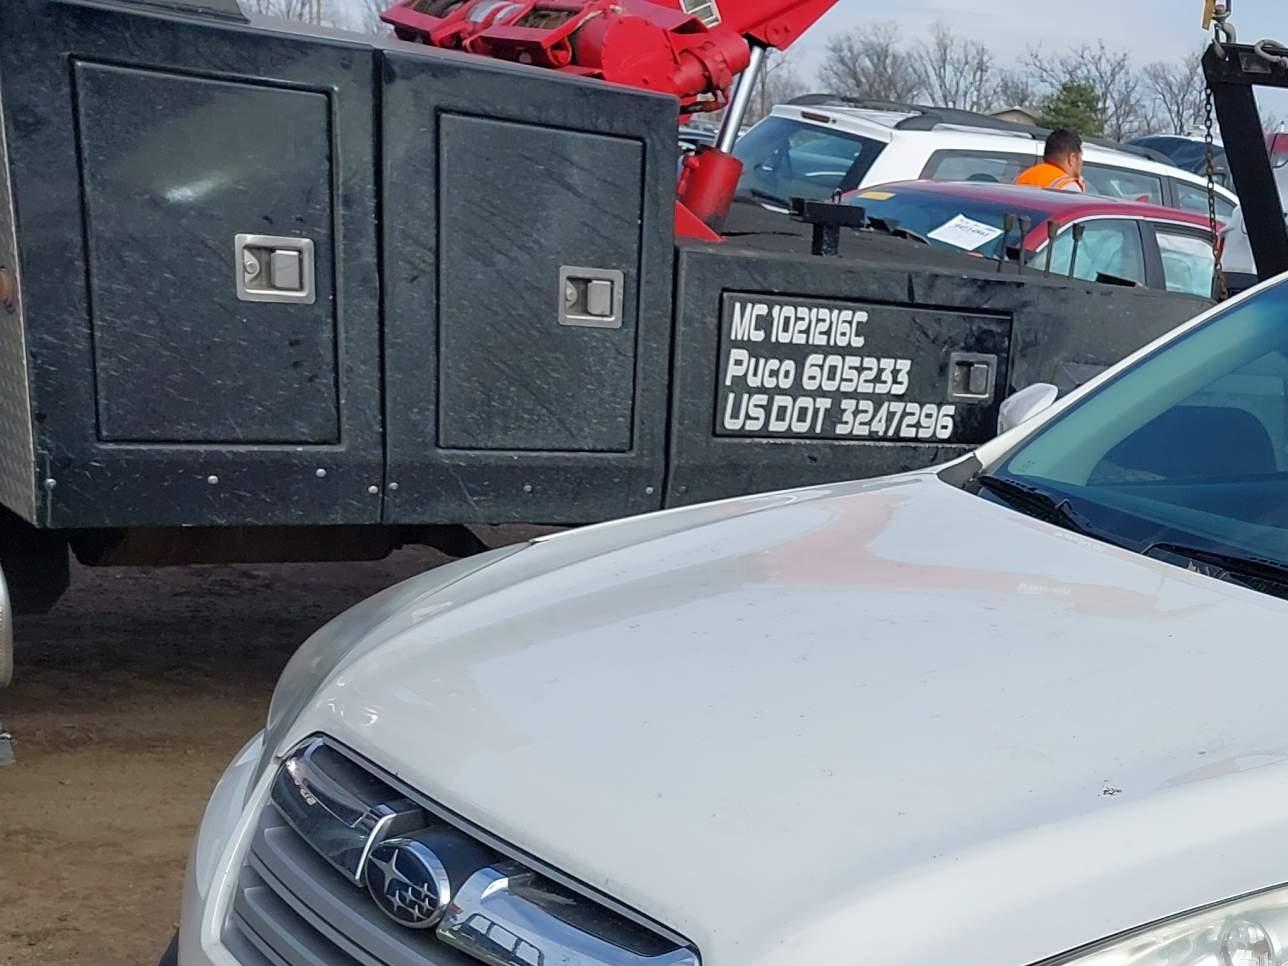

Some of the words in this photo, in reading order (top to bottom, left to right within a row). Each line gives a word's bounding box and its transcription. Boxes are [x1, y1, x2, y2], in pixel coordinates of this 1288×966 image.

[730, 302, 768, 342] MC
[771, 304, 869, 348] 1021216C
[725, 349, 796, 389] Puco
[802, 354, 912, 396] 605233
[835, 399, 955, 439] 3247296
